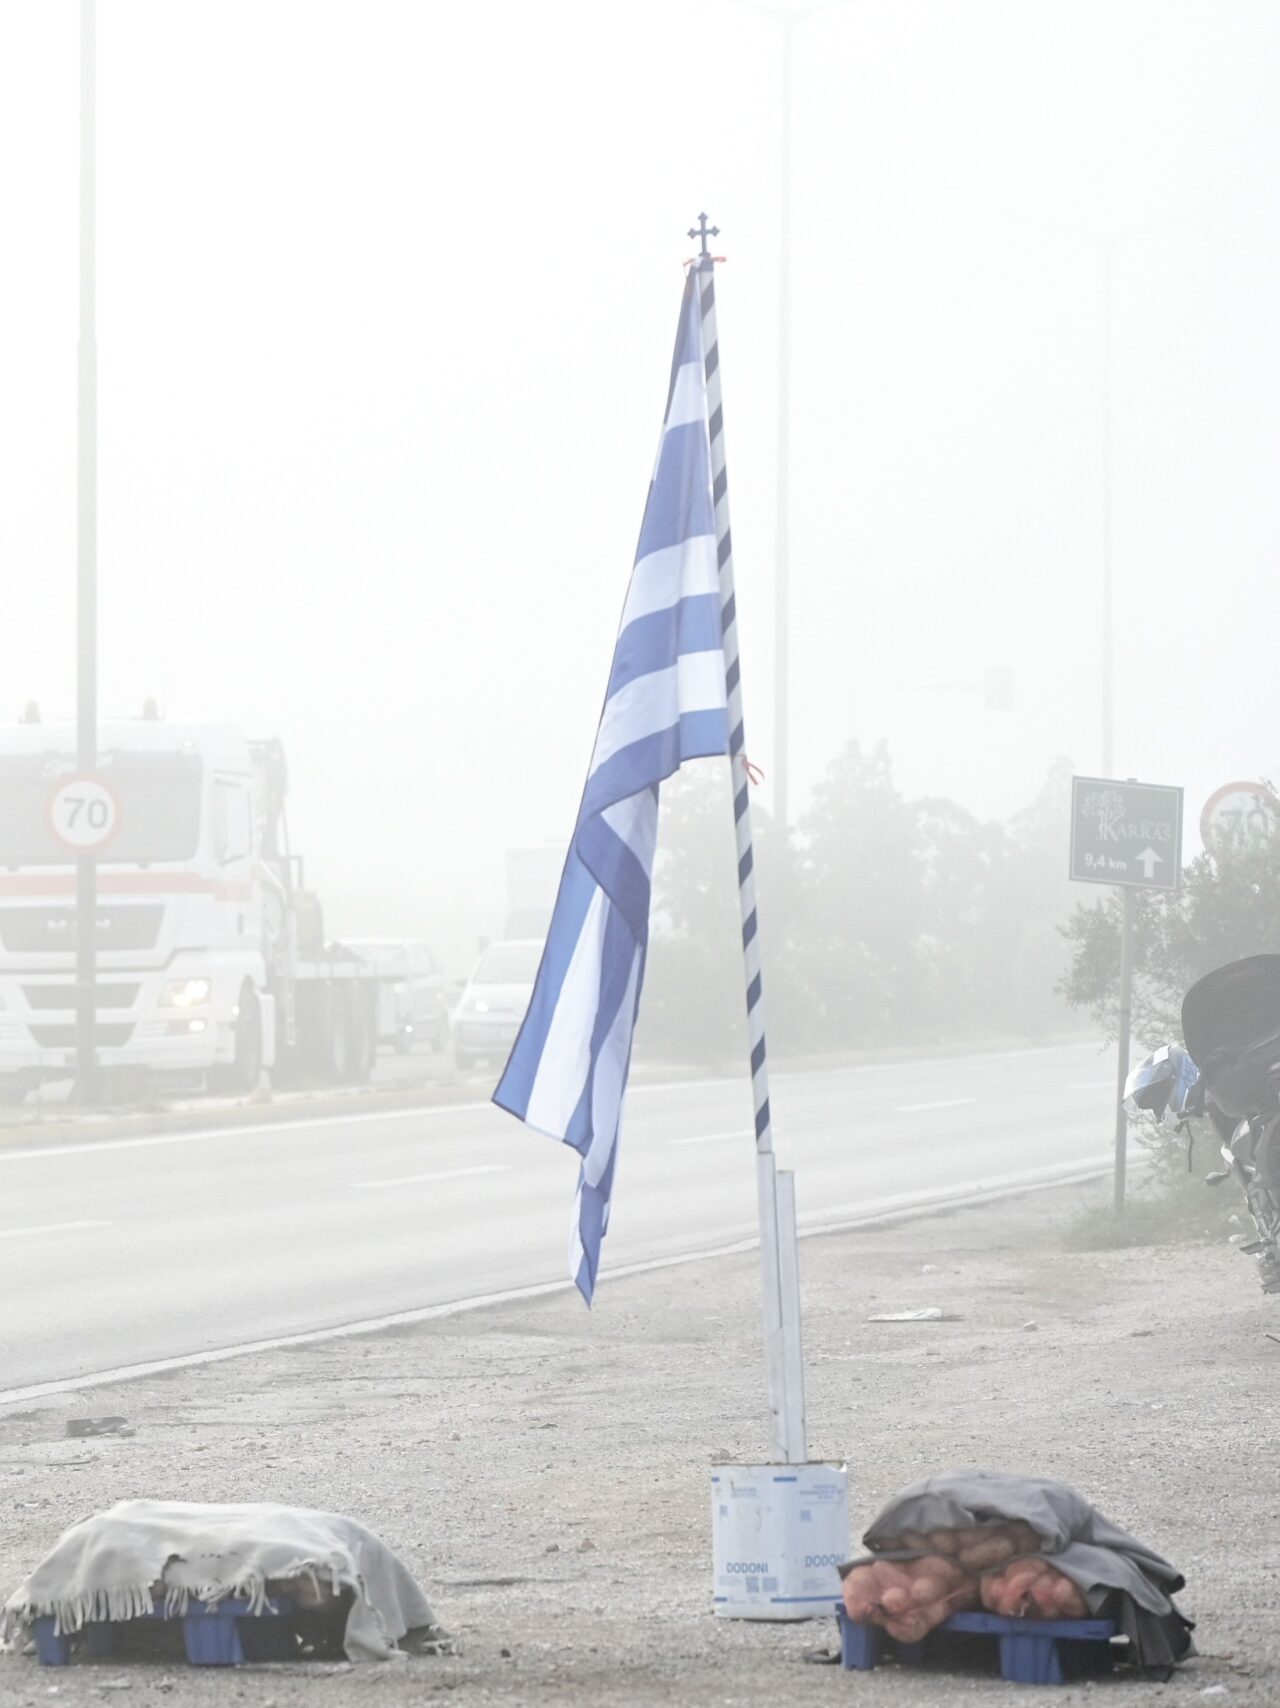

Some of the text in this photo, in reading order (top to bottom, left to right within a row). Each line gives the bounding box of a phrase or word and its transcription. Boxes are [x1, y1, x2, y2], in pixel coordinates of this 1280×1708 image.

[63, 798, 109, 829] 70
[1084, 853, 1128, 870] 9,4 km
[726, 1562, 768, 1573] DODONI
